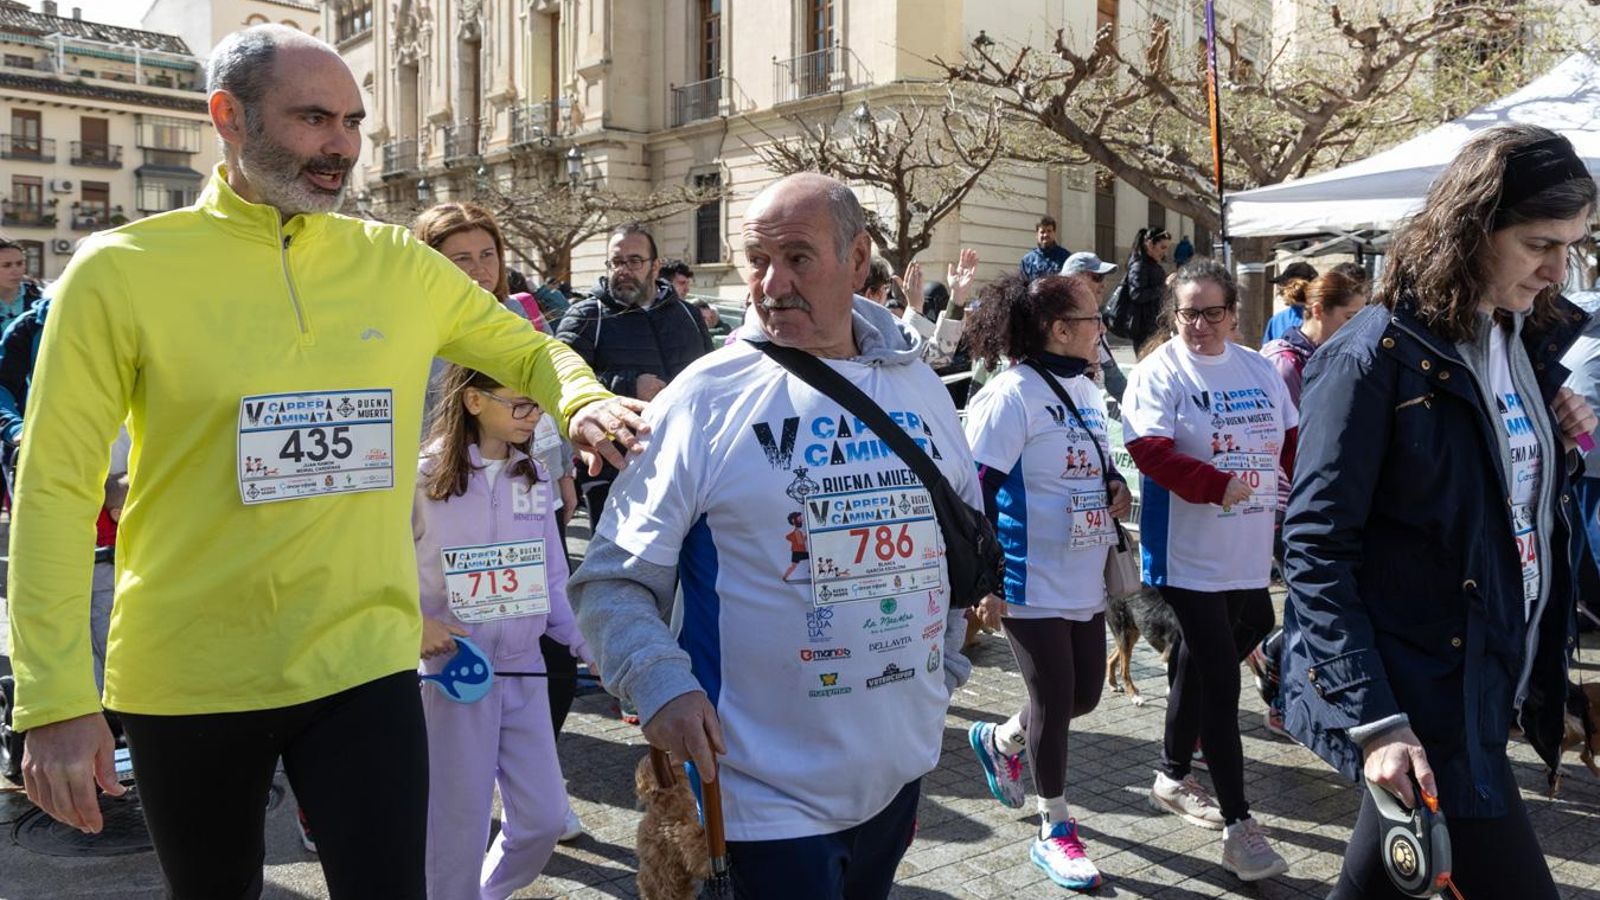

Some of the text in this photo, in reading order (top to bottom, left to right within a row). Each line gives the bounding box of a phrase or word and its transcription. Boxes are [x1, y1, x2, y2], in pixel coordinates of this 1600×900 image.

[246, 398, 333, 427] V CARRERA
[357, 398, 388, 409] BUENA
[357, 408, 388, 419] MUERTE
[264, 410, 333, 425] CAMINATA
[279, 426, 352, 463] 435
[752, 416, 800, 471] V
[822, 468, 922, 493] BUENA MUER
[512, 481, 547, 514] BE
[809, 494, 895, 526] V CARRERA
[911, 495, 929, 505] BUENA
[831, 507, 897, 525] CAMINATA
[1086, 509, 1107, 529] 941
[849, 523, 914, 564] 786
[445, 552, 457, 567] V
[468, 567, 518, 597] 713
